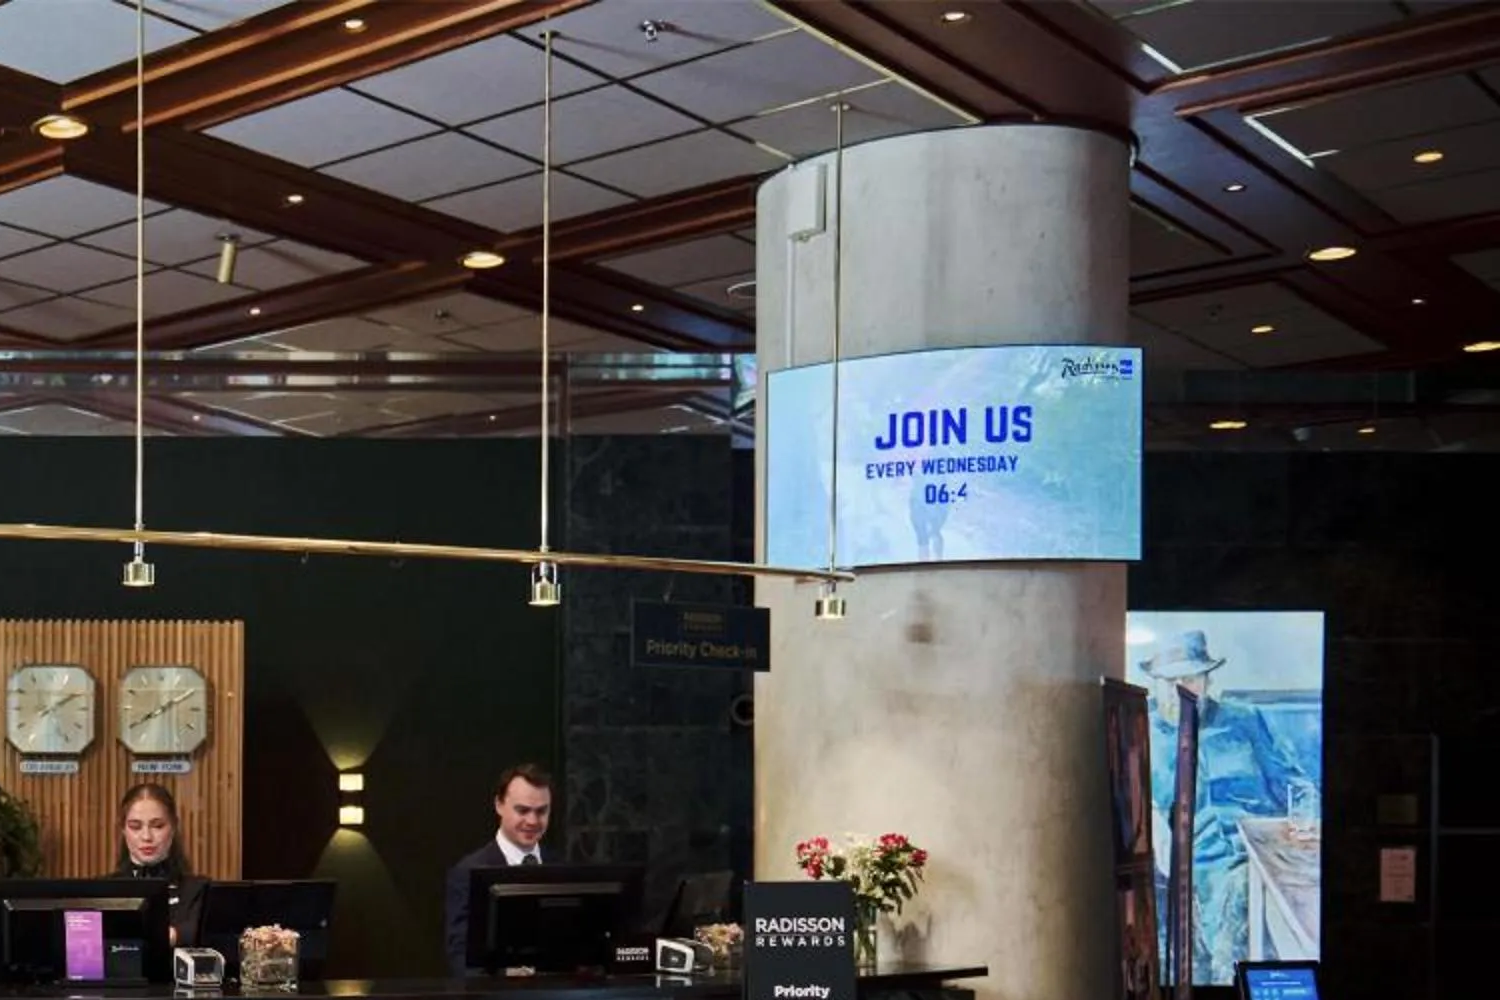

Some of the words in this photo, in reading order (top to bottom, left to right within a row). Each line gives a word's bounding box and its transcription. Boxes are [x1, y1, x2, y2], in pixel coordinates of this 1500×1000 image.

[874, 406, 968, 451] JOIN
[984, 404, 1033, 443] US
[865, 460, 916, 480] EVERY
[921, 455, 1019, 475] WEDNESDAY
[645, 639, 698, 659] Priority
[754, 916, 846, 933] RADISSON
[754, 935, 846, 948] REWARDS
[773, 984, 831, 999] Priority
